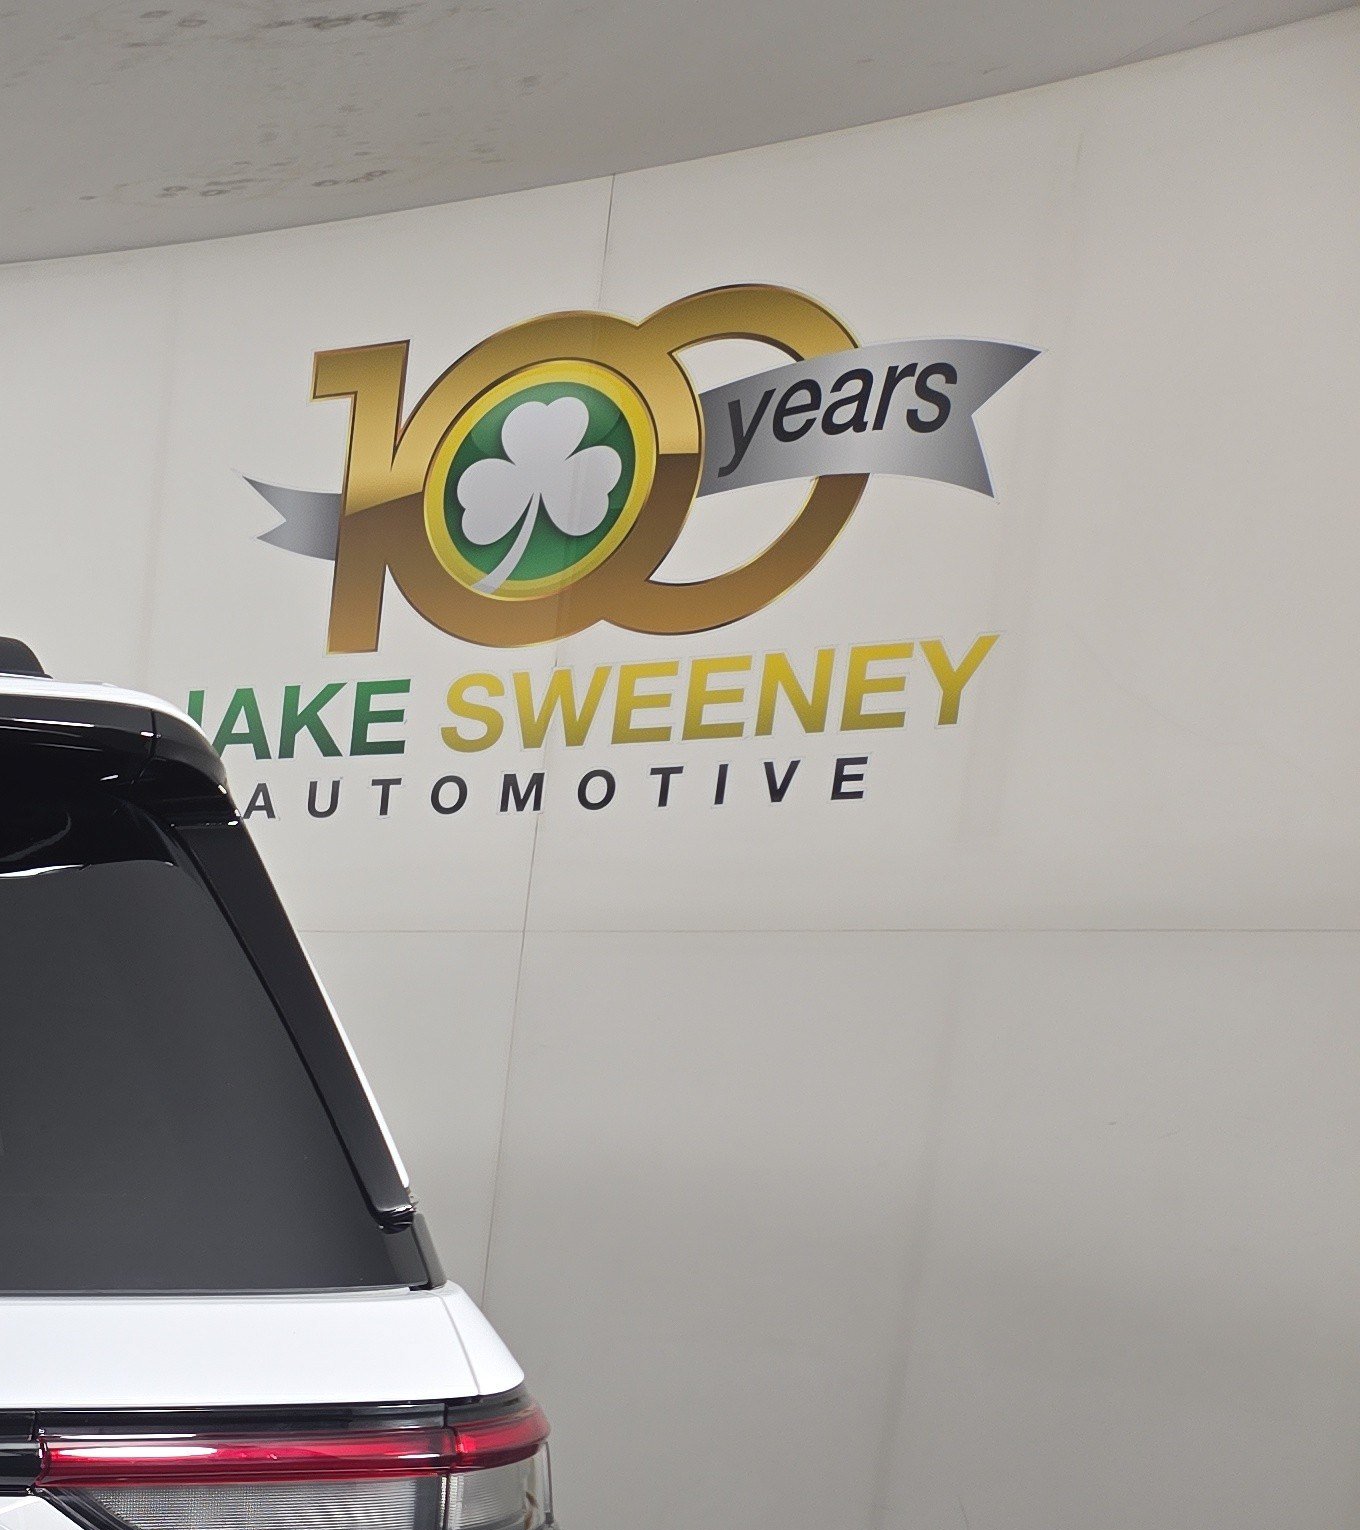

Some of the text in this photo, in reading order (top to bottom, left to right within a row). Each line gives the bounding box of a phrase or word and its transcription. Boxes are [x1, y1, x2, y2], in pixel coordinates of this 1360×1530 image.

[311, 283, 958, 653] 100 years
[441, 633, 1000, 753] SWEENEY
[242, 755, 869, 820] AUTOMOTIVE
